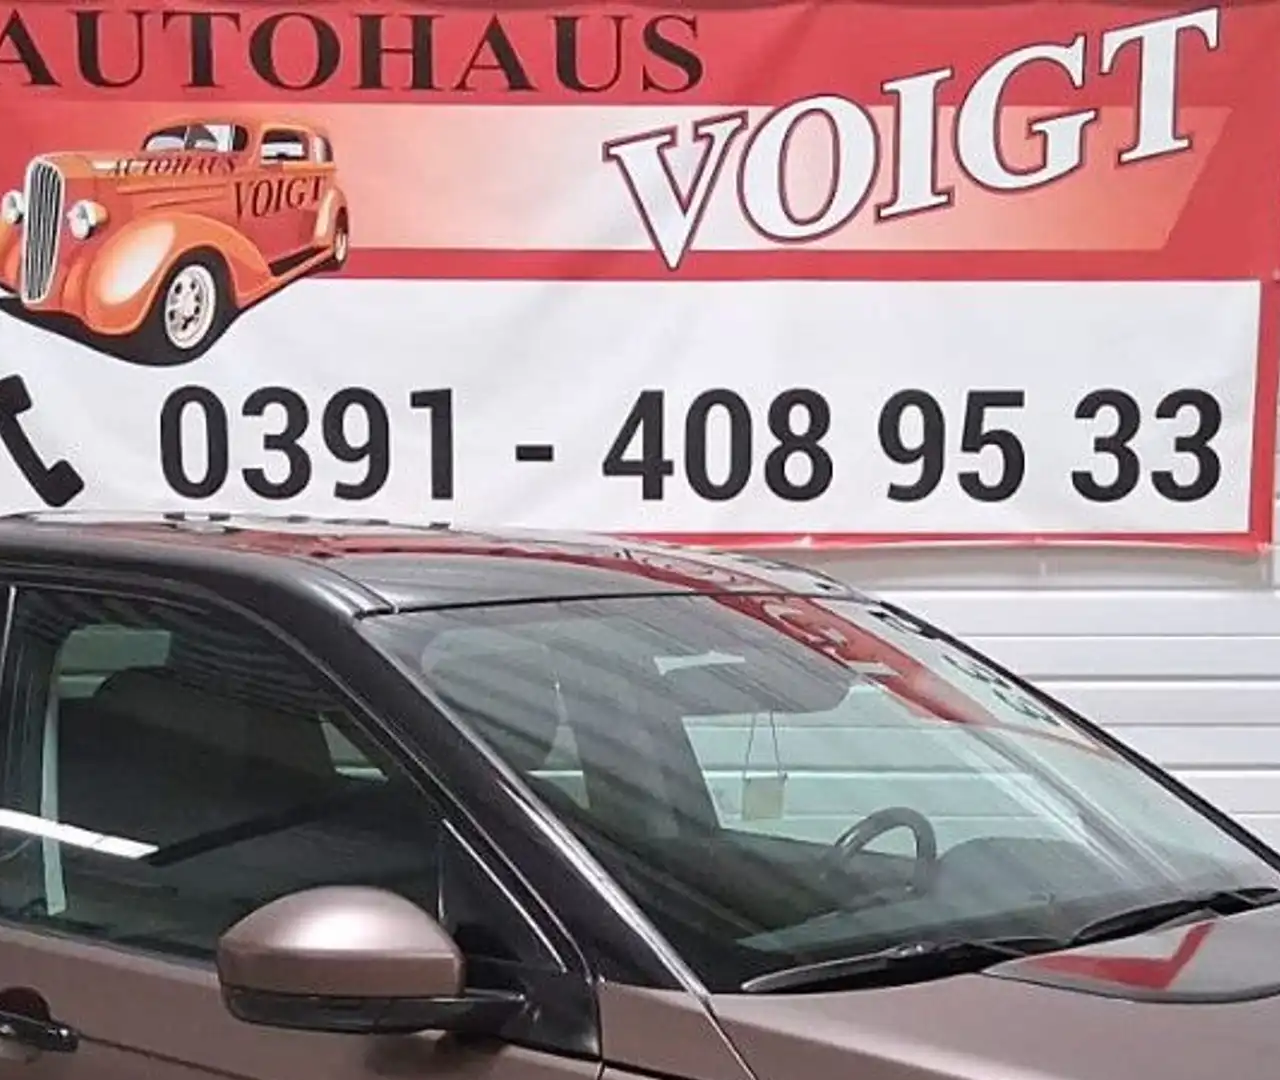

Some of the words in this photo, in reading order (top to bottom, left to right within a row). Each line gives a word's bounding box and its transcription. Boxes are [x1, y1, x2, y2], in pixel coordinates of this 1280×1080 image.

[110, 155, 239, 176] AUTOHAUS
[603, 8, 1219, 270] VOIGT
[234, 175, 327, 219] VOIGT
[159, 385, 455, 501] 0391
[603, 388, 835, 502] 408
[878, 388, 1027, 502] 95
[1072, 389, 1223, 502] 33
